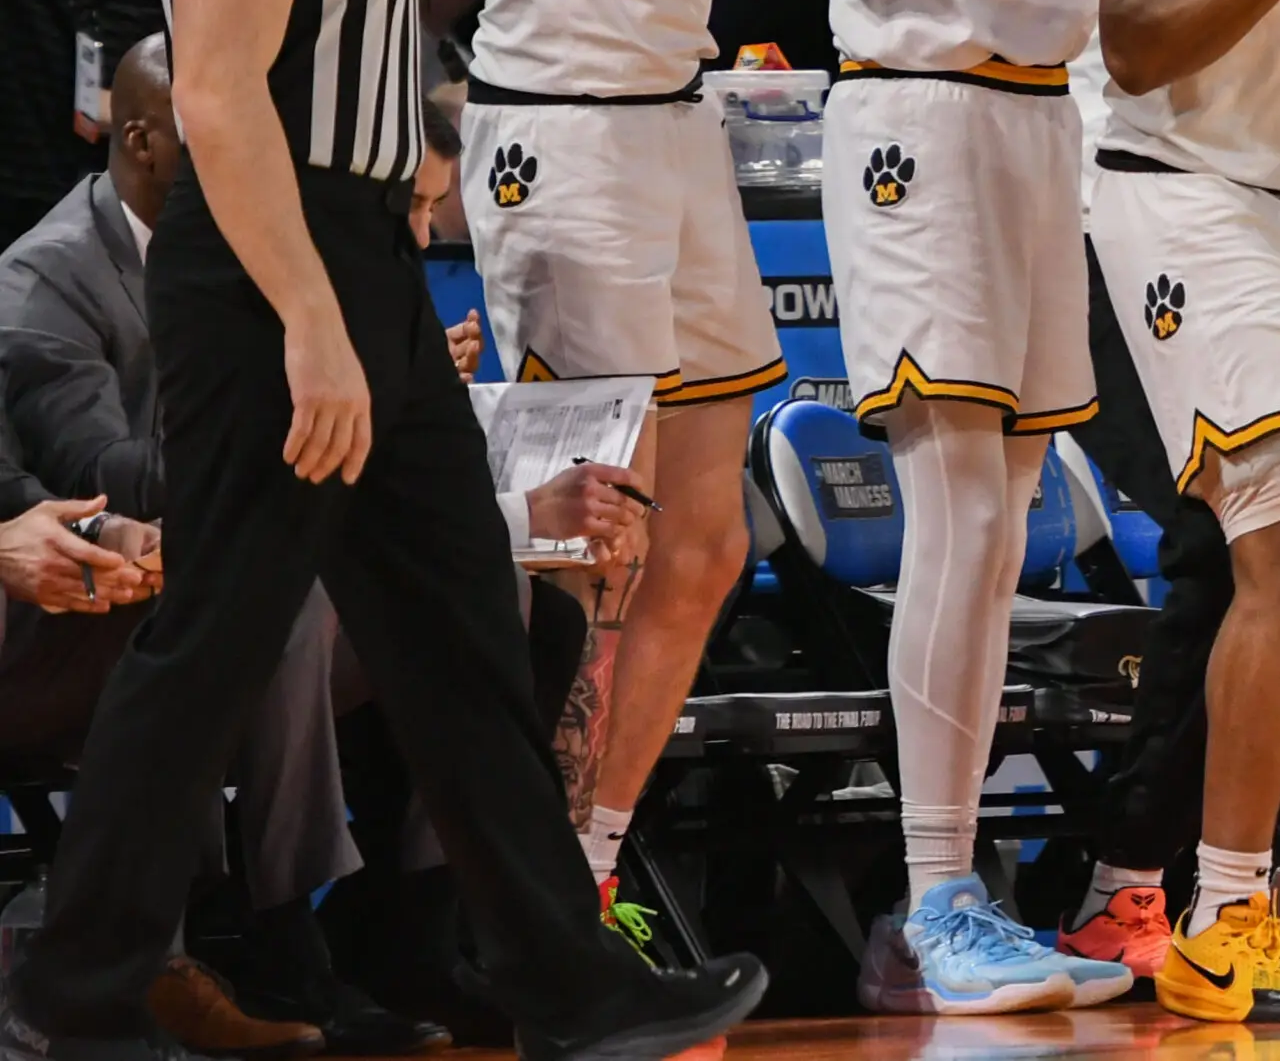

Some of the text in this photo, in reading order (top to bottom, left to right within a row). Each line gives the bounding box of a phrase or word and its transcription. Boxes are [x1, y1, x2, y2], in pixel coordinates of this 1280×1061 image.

[498, 182, 522, 204] M
[876, 182, 899, 203] M
[775, 713, 791, 729] THE
